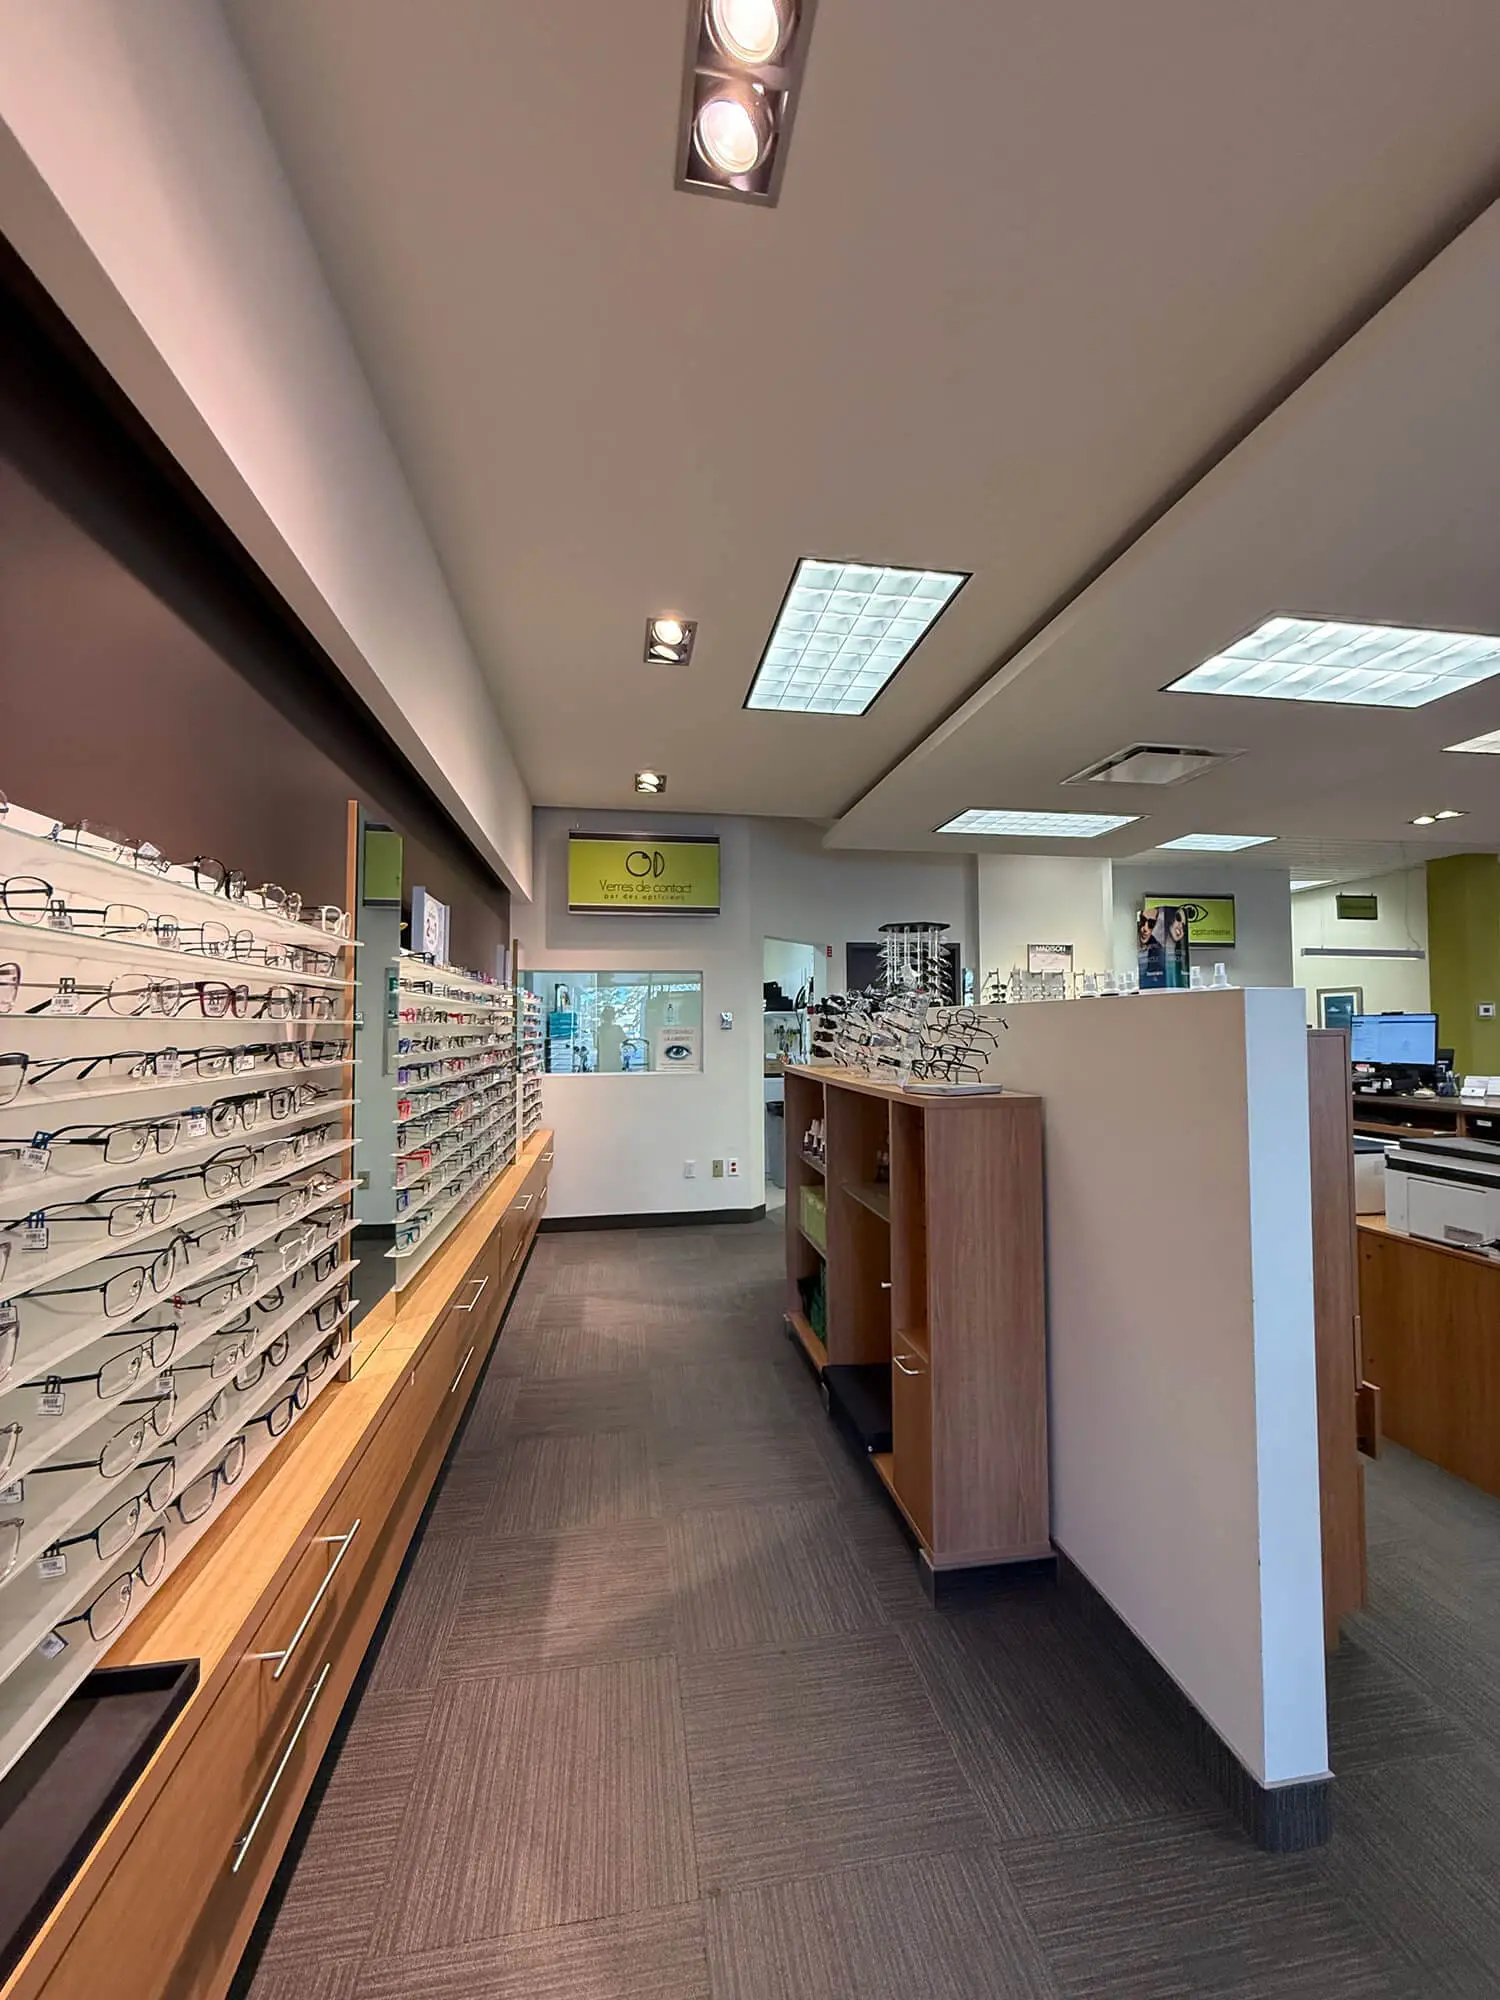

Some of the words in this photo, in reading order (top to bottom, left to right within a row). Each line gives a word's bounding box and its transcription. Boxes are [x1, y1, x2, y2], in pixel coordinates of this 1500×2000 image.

[600, 880, 634, 892] Verres
[636, 880, 651, 892] de
[653, 882, 692, 893] contact
